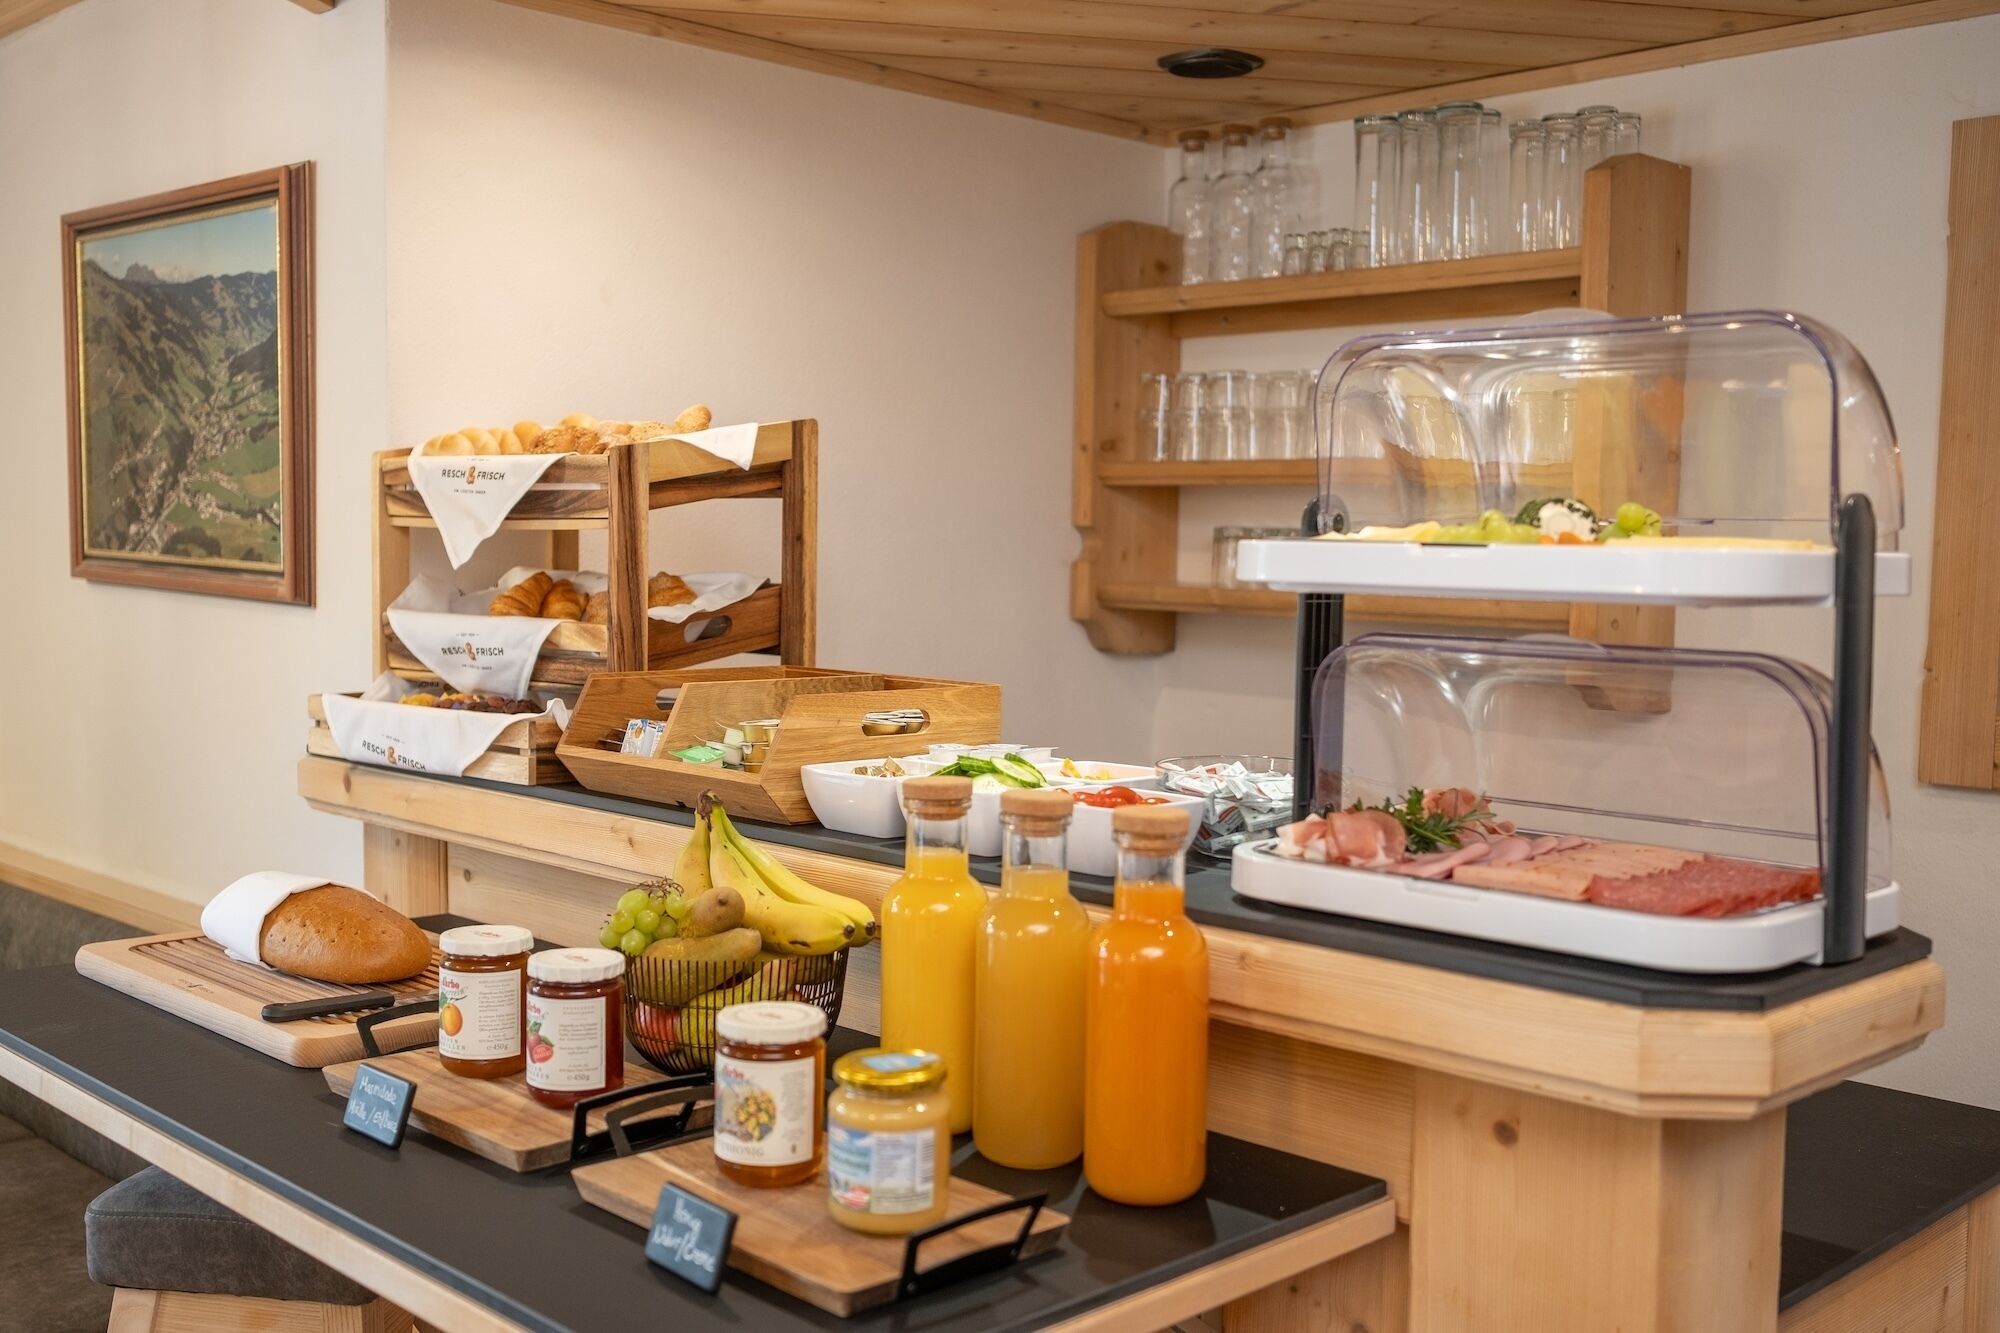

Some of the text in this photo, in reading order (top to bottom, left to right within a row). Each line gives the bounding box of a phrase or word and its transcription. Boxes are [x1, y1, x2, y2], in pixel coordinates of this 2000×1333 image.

[441, 469, 466, 479] RESCH
[476, 471, 505, 480] FRISCH
[475, 647, 504, 656] FRISCH
[362, 740, 386, 757] RESCH
